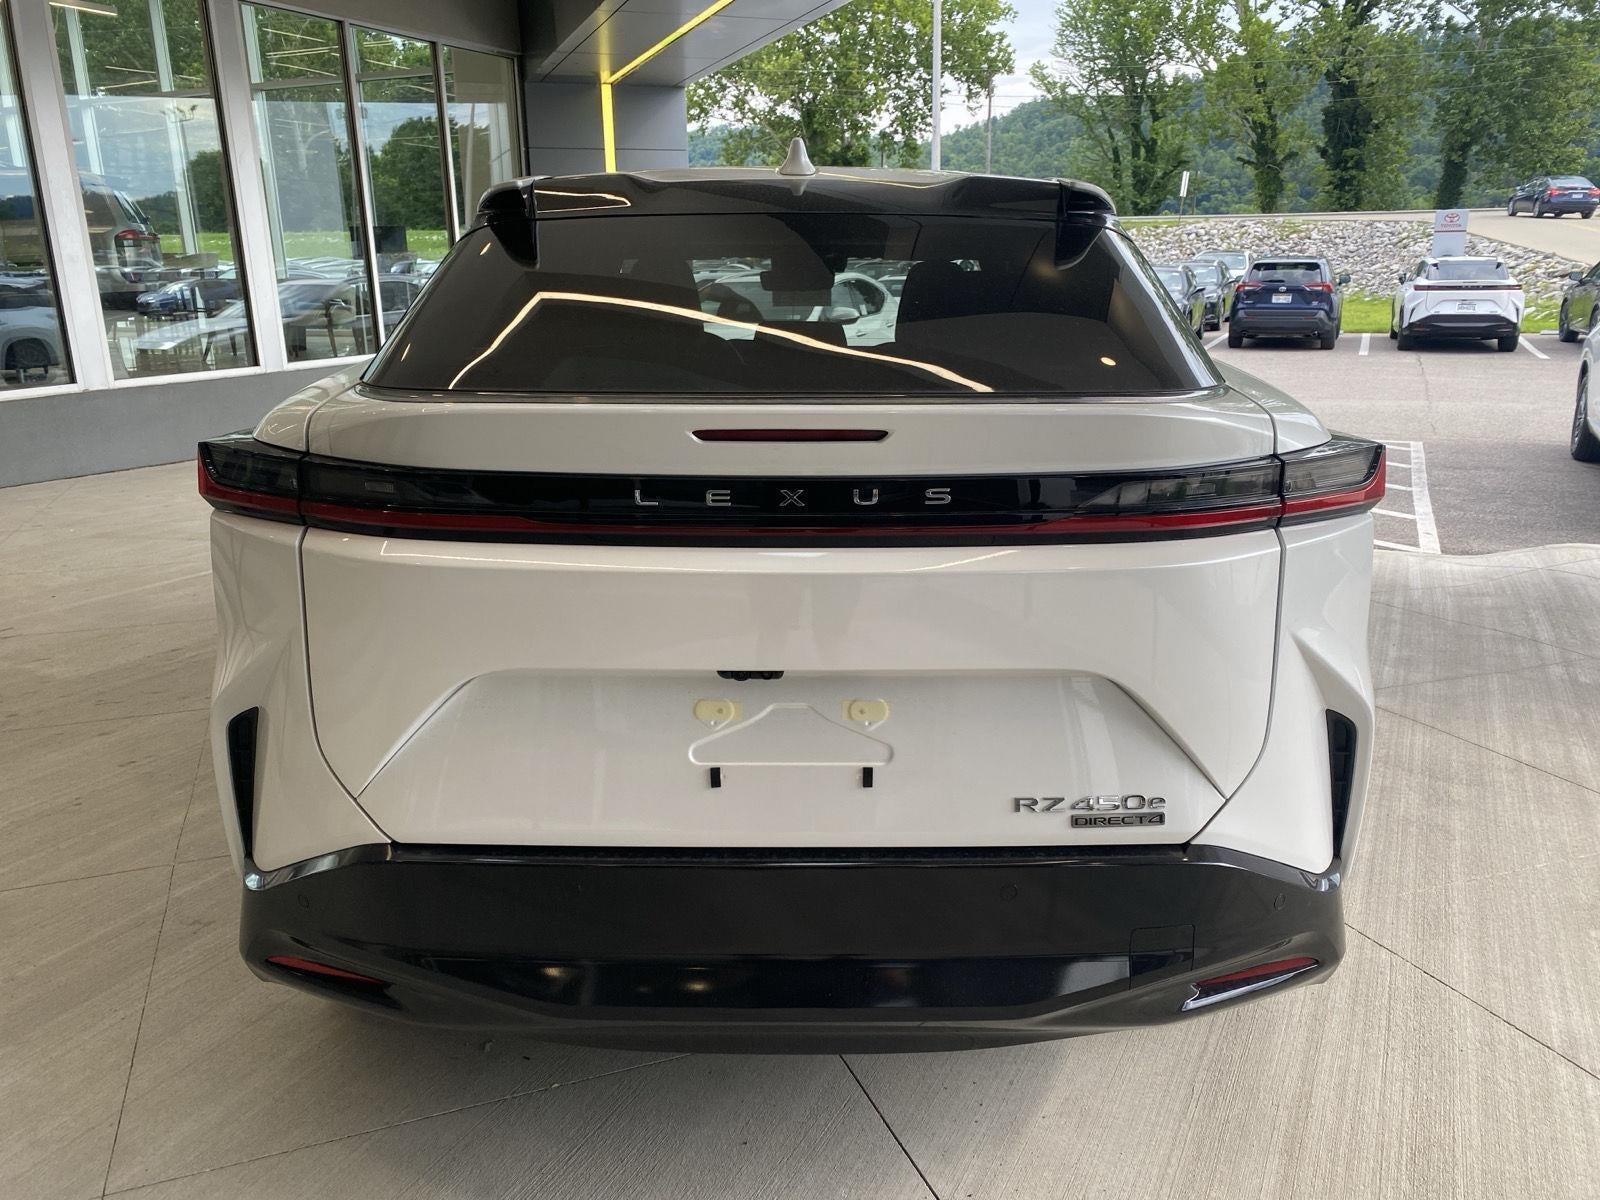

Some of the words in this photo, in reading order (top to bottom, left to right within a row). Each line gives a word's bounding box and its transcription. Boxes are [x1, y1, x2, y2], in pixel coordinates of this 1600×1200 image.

[634, 488, 952, 507] LEXUS
[1014, 796, 1066, 813] RZ
[1070, 794, 1167, 812] 450e
[1073, 813, 1165, 827] DIRECT4
